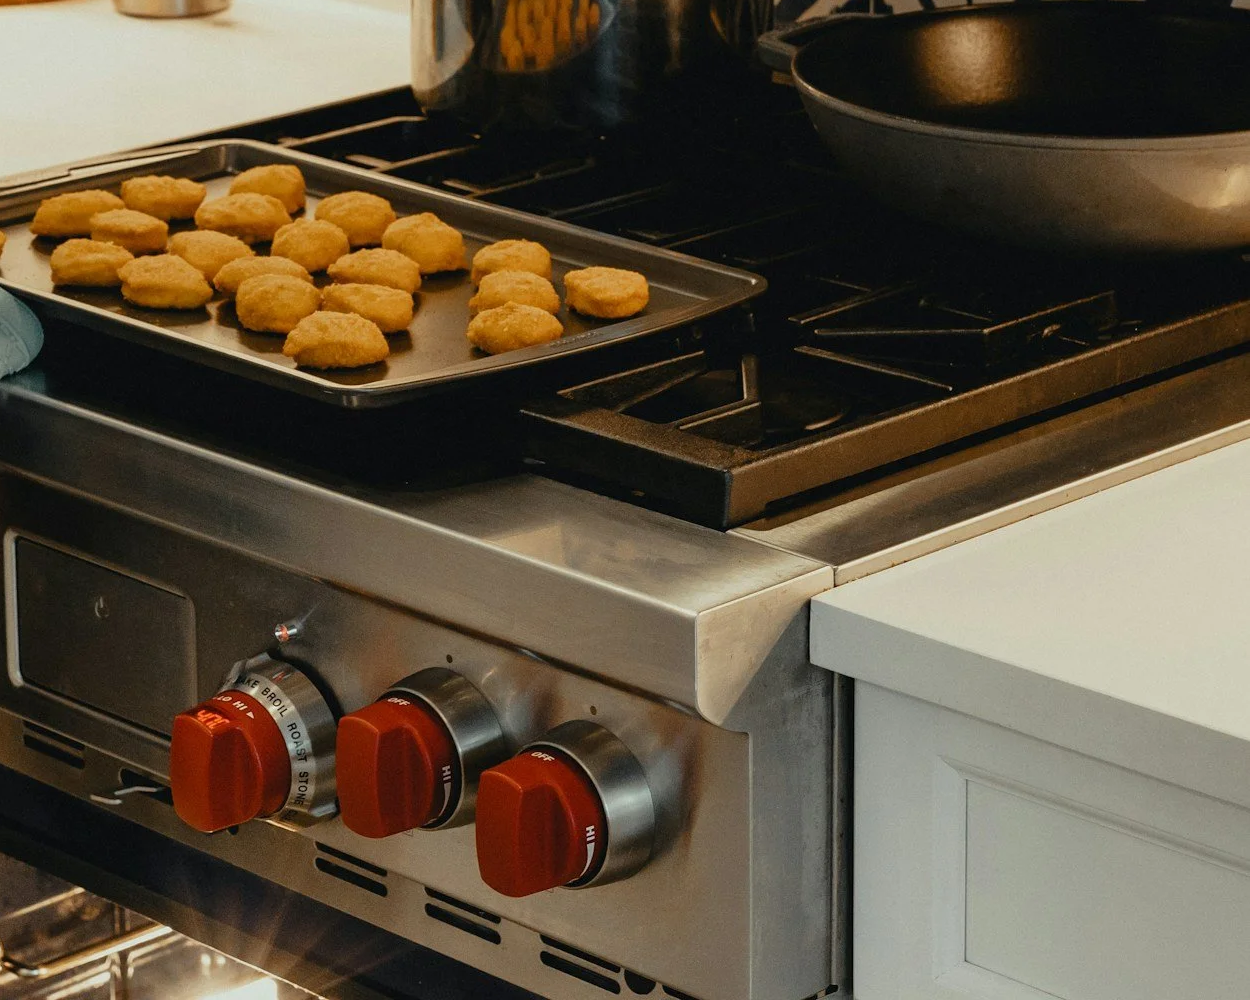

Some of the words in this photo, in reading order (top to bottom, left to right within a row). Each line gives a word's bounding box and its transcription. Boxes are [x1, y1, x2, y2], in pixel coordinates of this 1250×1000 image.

[232, 700, 248, 711] HI
[387, 697, 410, 706] OFF
[261, 687, 288, 718] BROIL
[287, 722, 308, 763] ROAST
[531, 751, 555, 762] OFF
[442, 765, 451, 781] HI
[586, 825, 596, 842] HI
